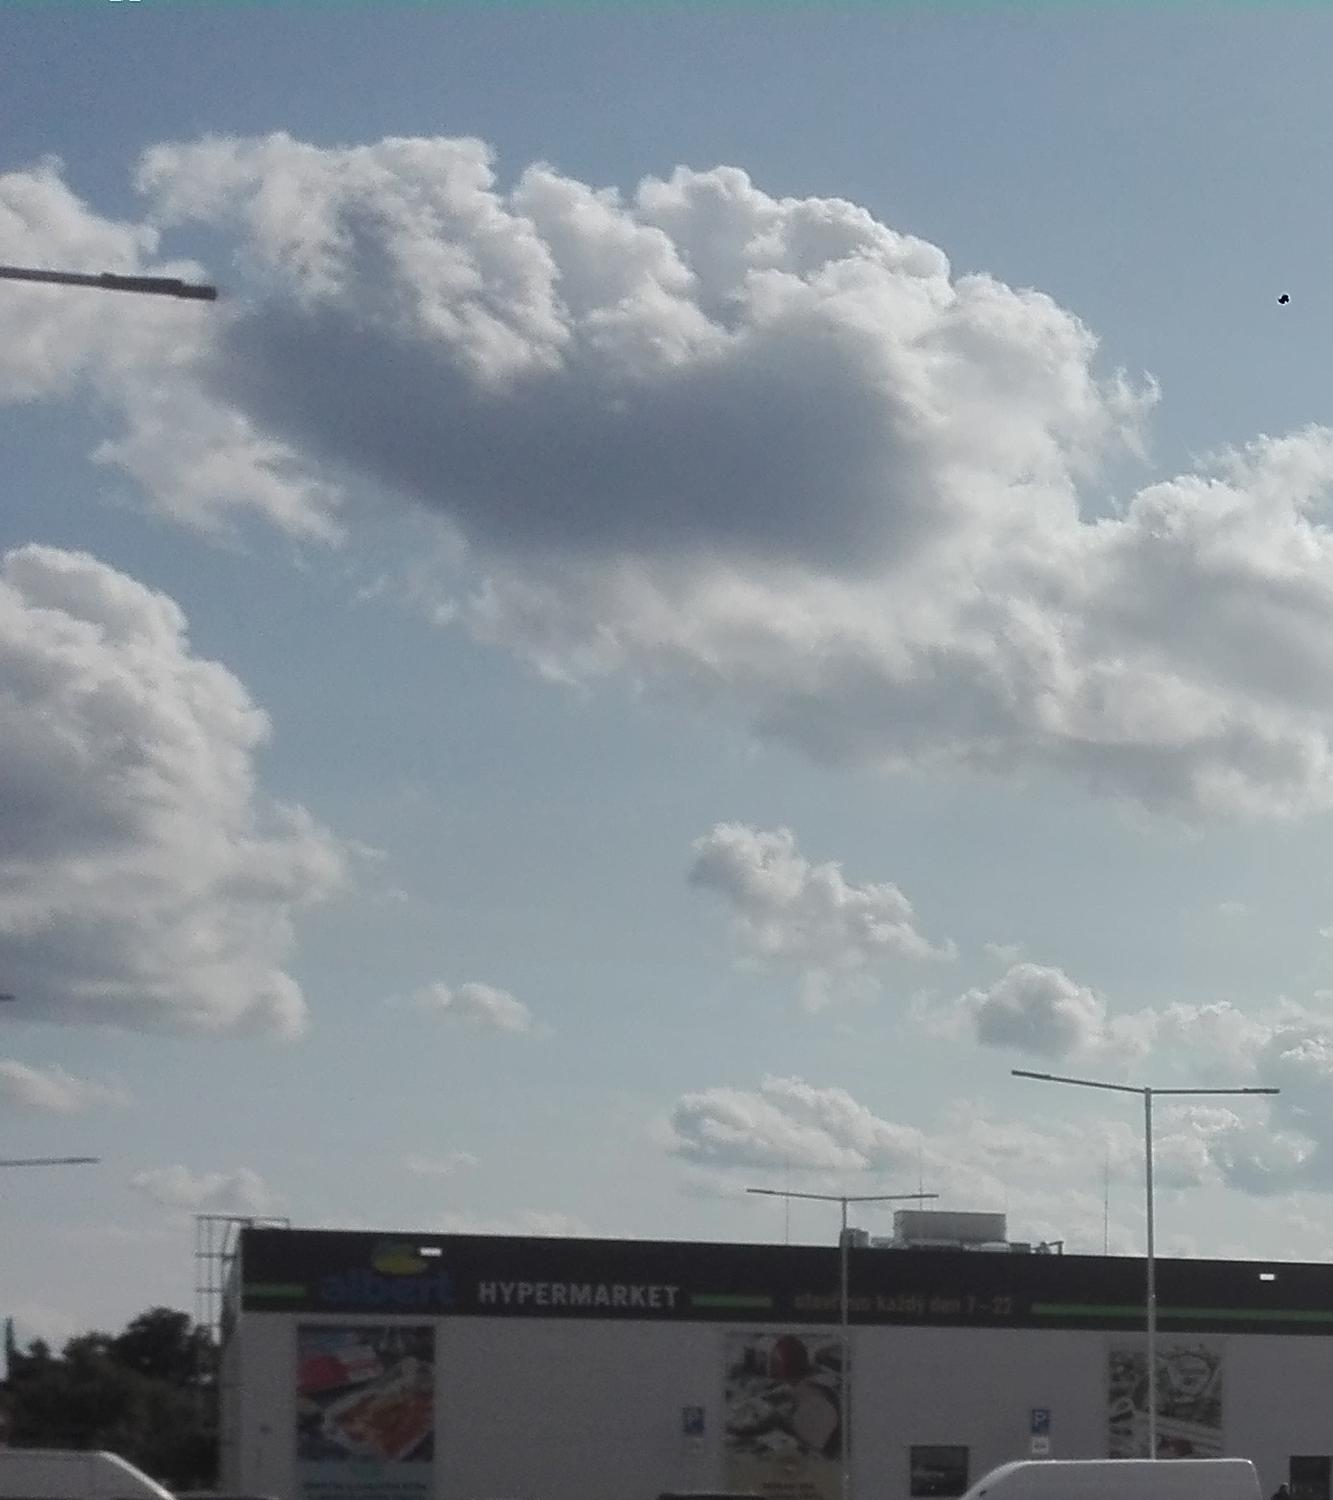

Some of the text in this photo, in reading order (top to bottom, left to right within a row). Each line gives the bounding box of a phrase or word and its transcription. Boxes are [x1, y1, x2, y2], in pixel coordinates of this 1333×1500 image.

[319, 1266, 456, 1306] albert
[474, 1280, 681, 1309] HYPERMARKET
[793, 1293, 872, 1312] otevřno
